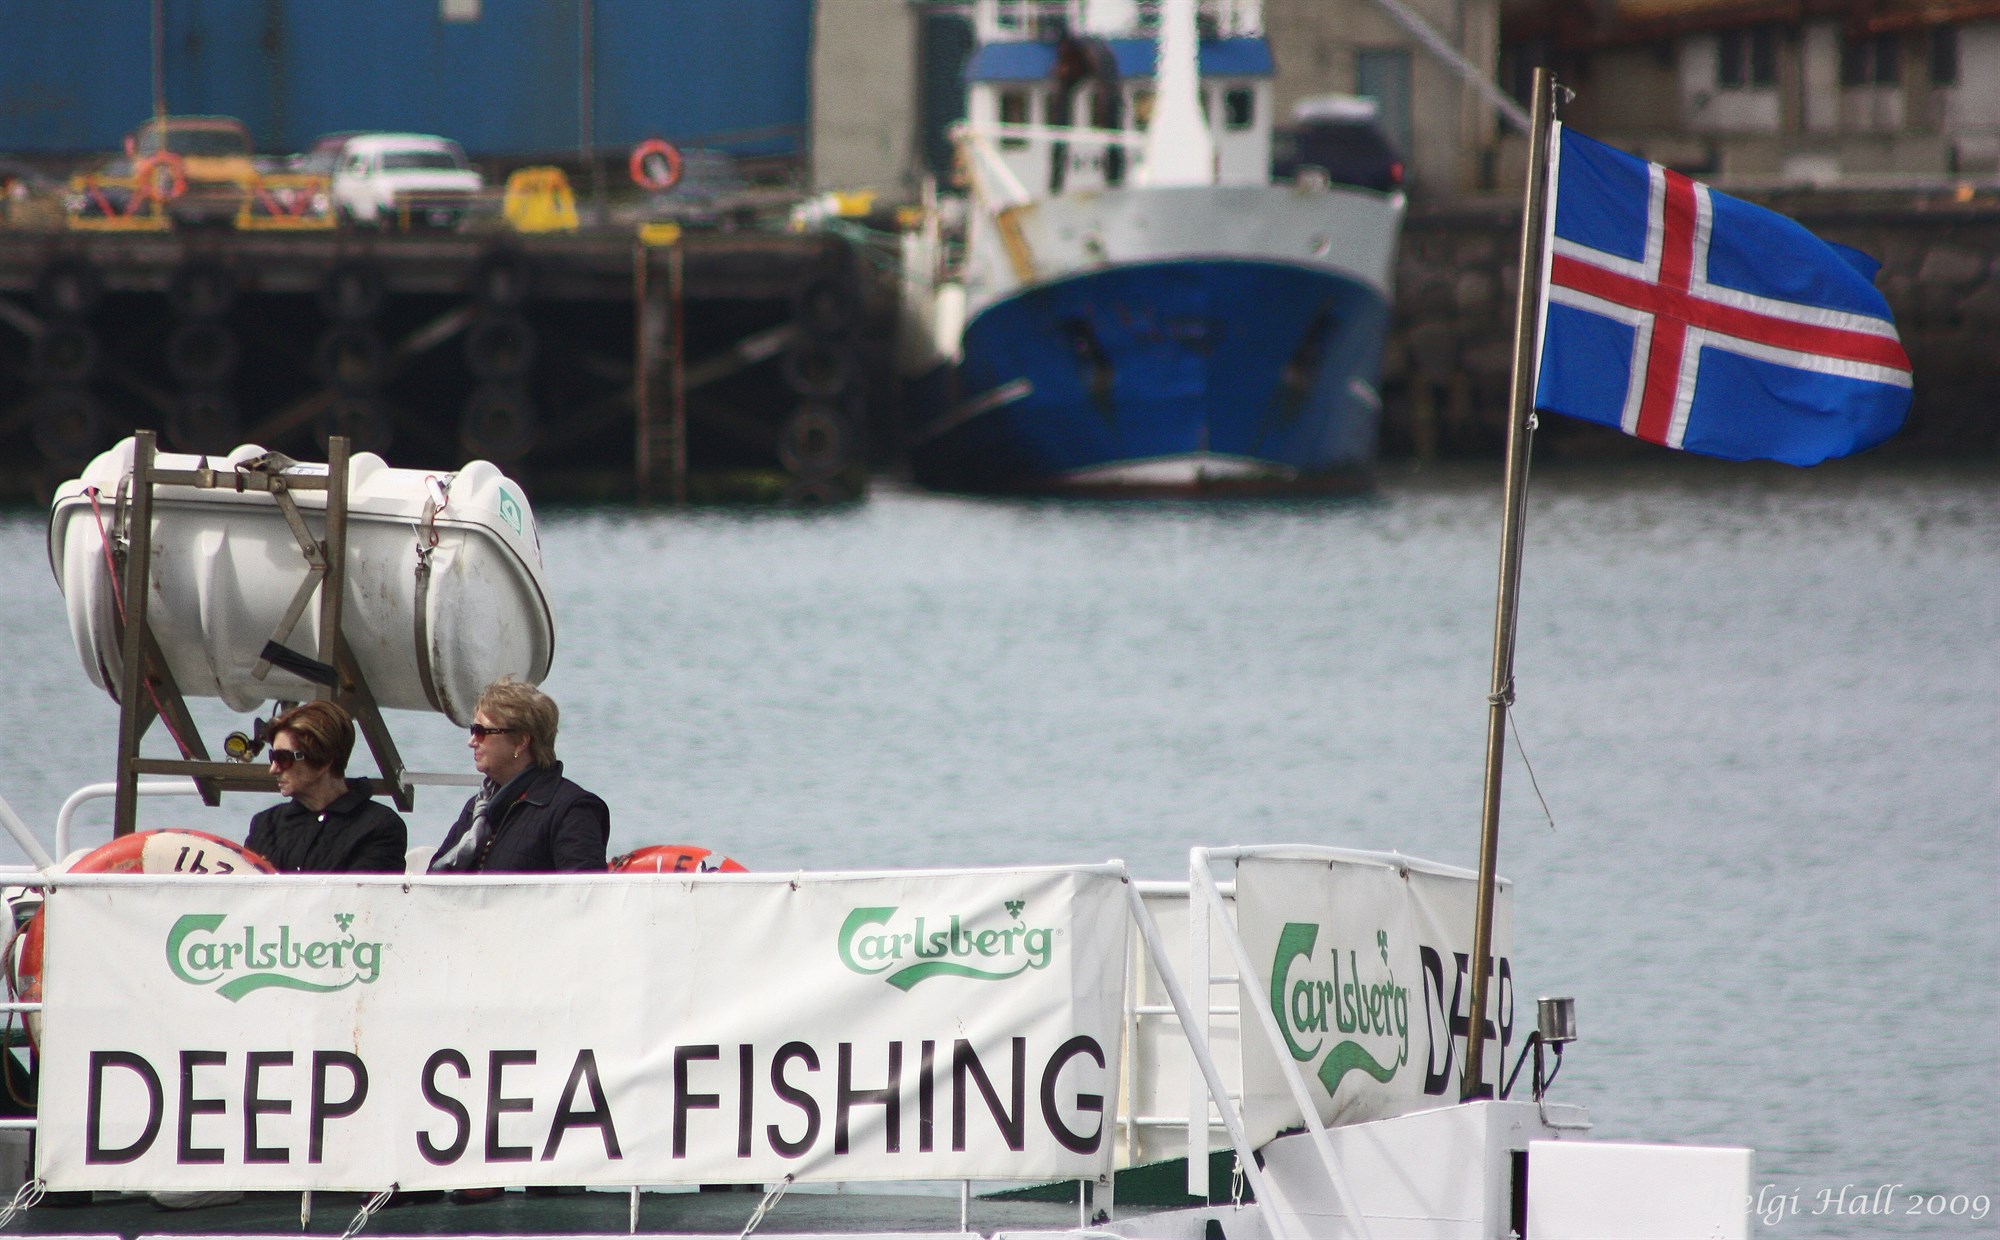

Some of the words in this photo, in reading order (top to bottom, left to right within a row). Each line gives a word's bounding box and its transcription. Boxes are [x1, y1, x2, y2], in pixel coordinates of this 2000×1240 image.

[165, 913, 387, 984] Carlsberg
[837, 905, 1053, 976] Carlsberg
[1271, 922, 1409, 1067] Carlsberg
[85, 1050, 369, 1166] DEEP
[416, 1047, 624, 1167] SEA
[672, 1034, 1107, 1160] FISHING
